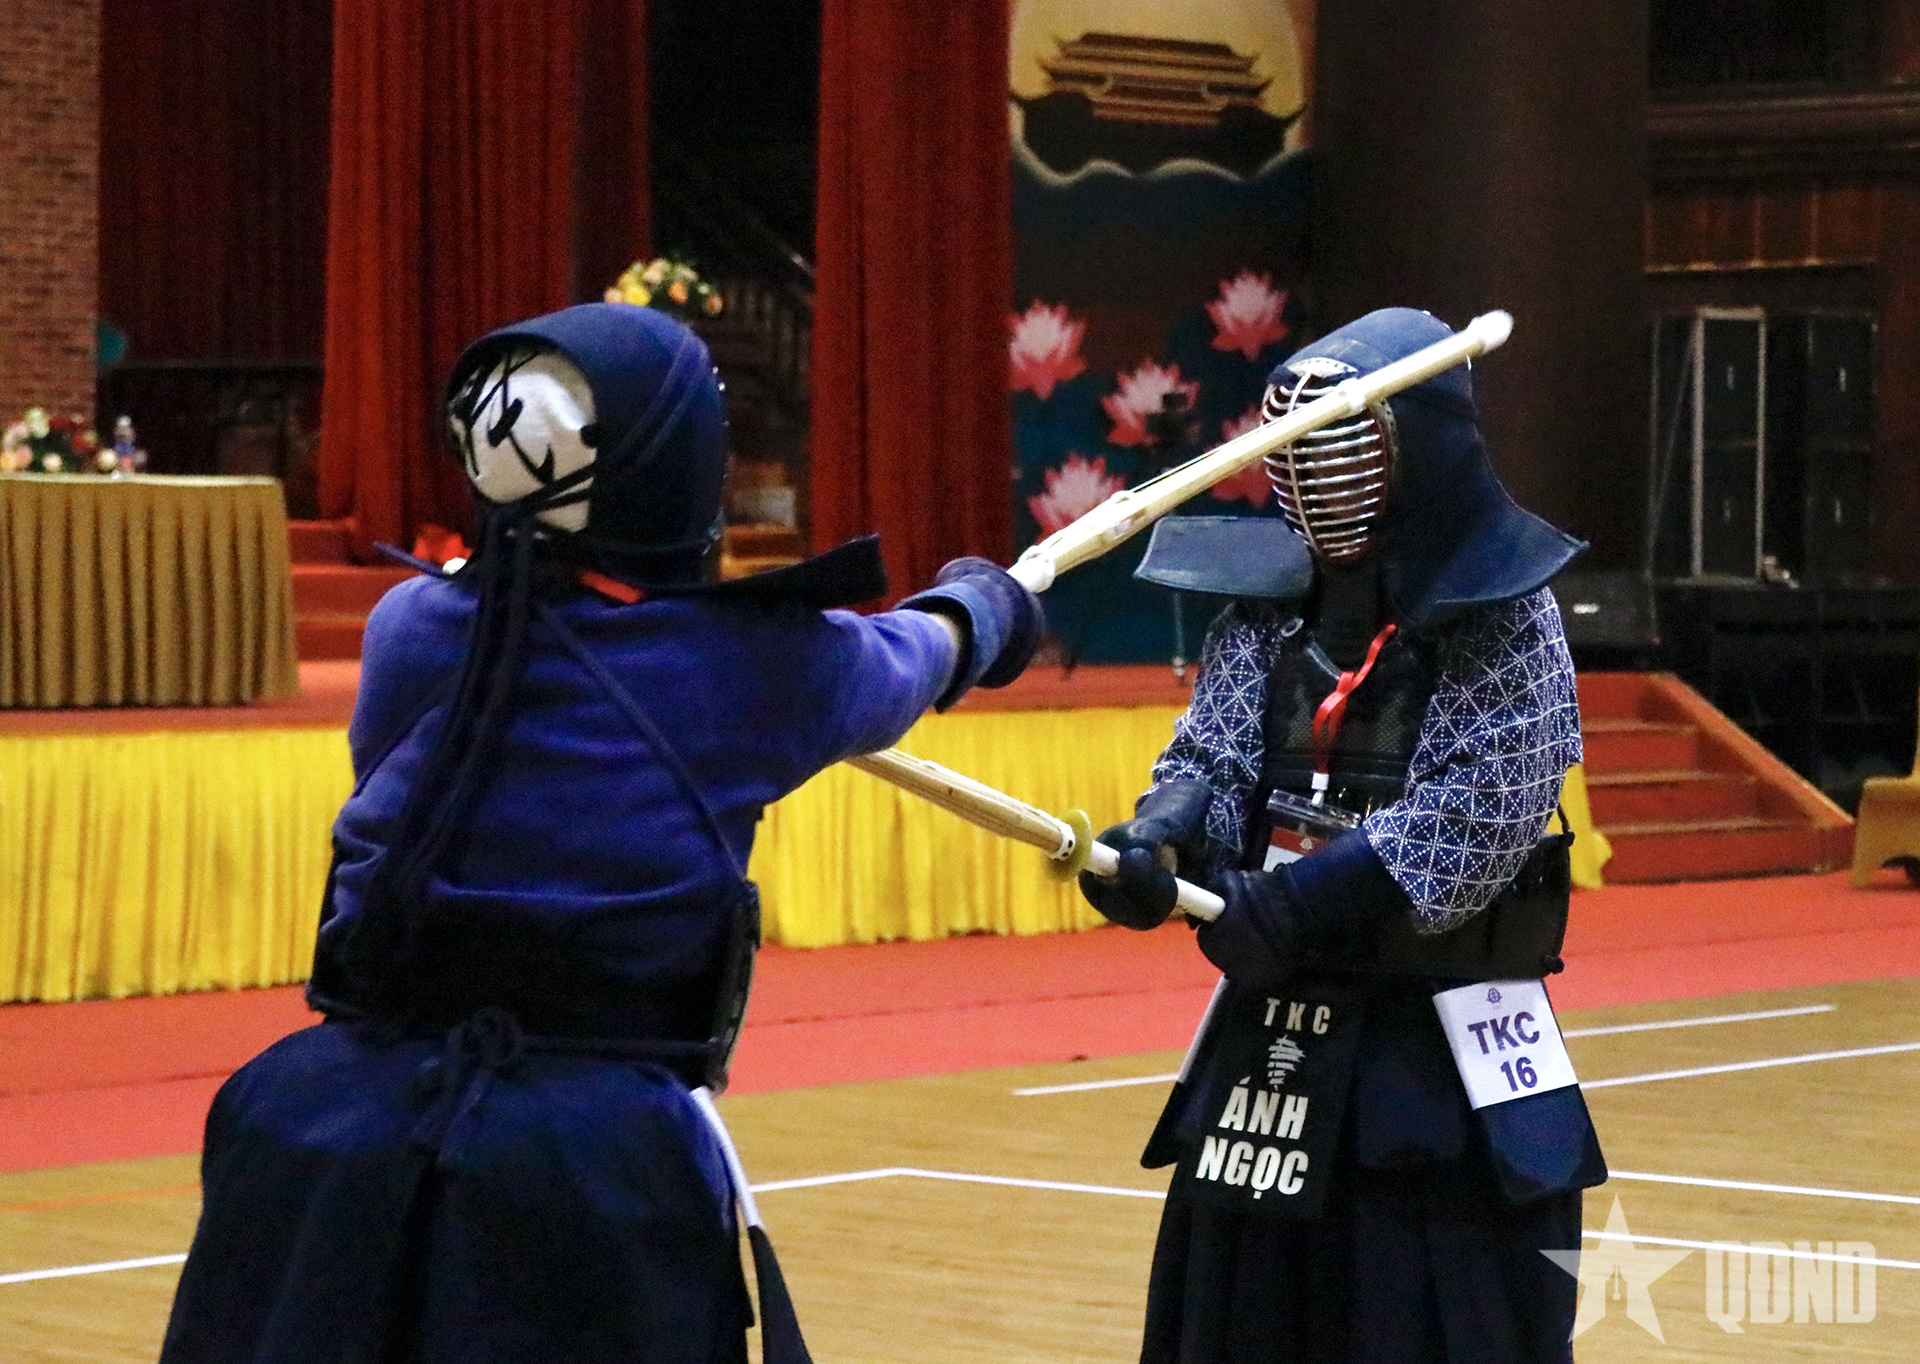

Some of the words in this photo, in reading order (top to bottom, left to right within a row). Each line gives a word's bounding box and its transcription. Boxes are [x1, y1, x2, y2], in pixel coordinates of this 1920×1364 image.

[1467, 1011, 1540, 1055] TKC
[1499, 1056, 1538, 1093] 16
[1217, 1075, 1309, 1140] ÁNH
[1195, 1135, 1309, 1200] NGỌC
